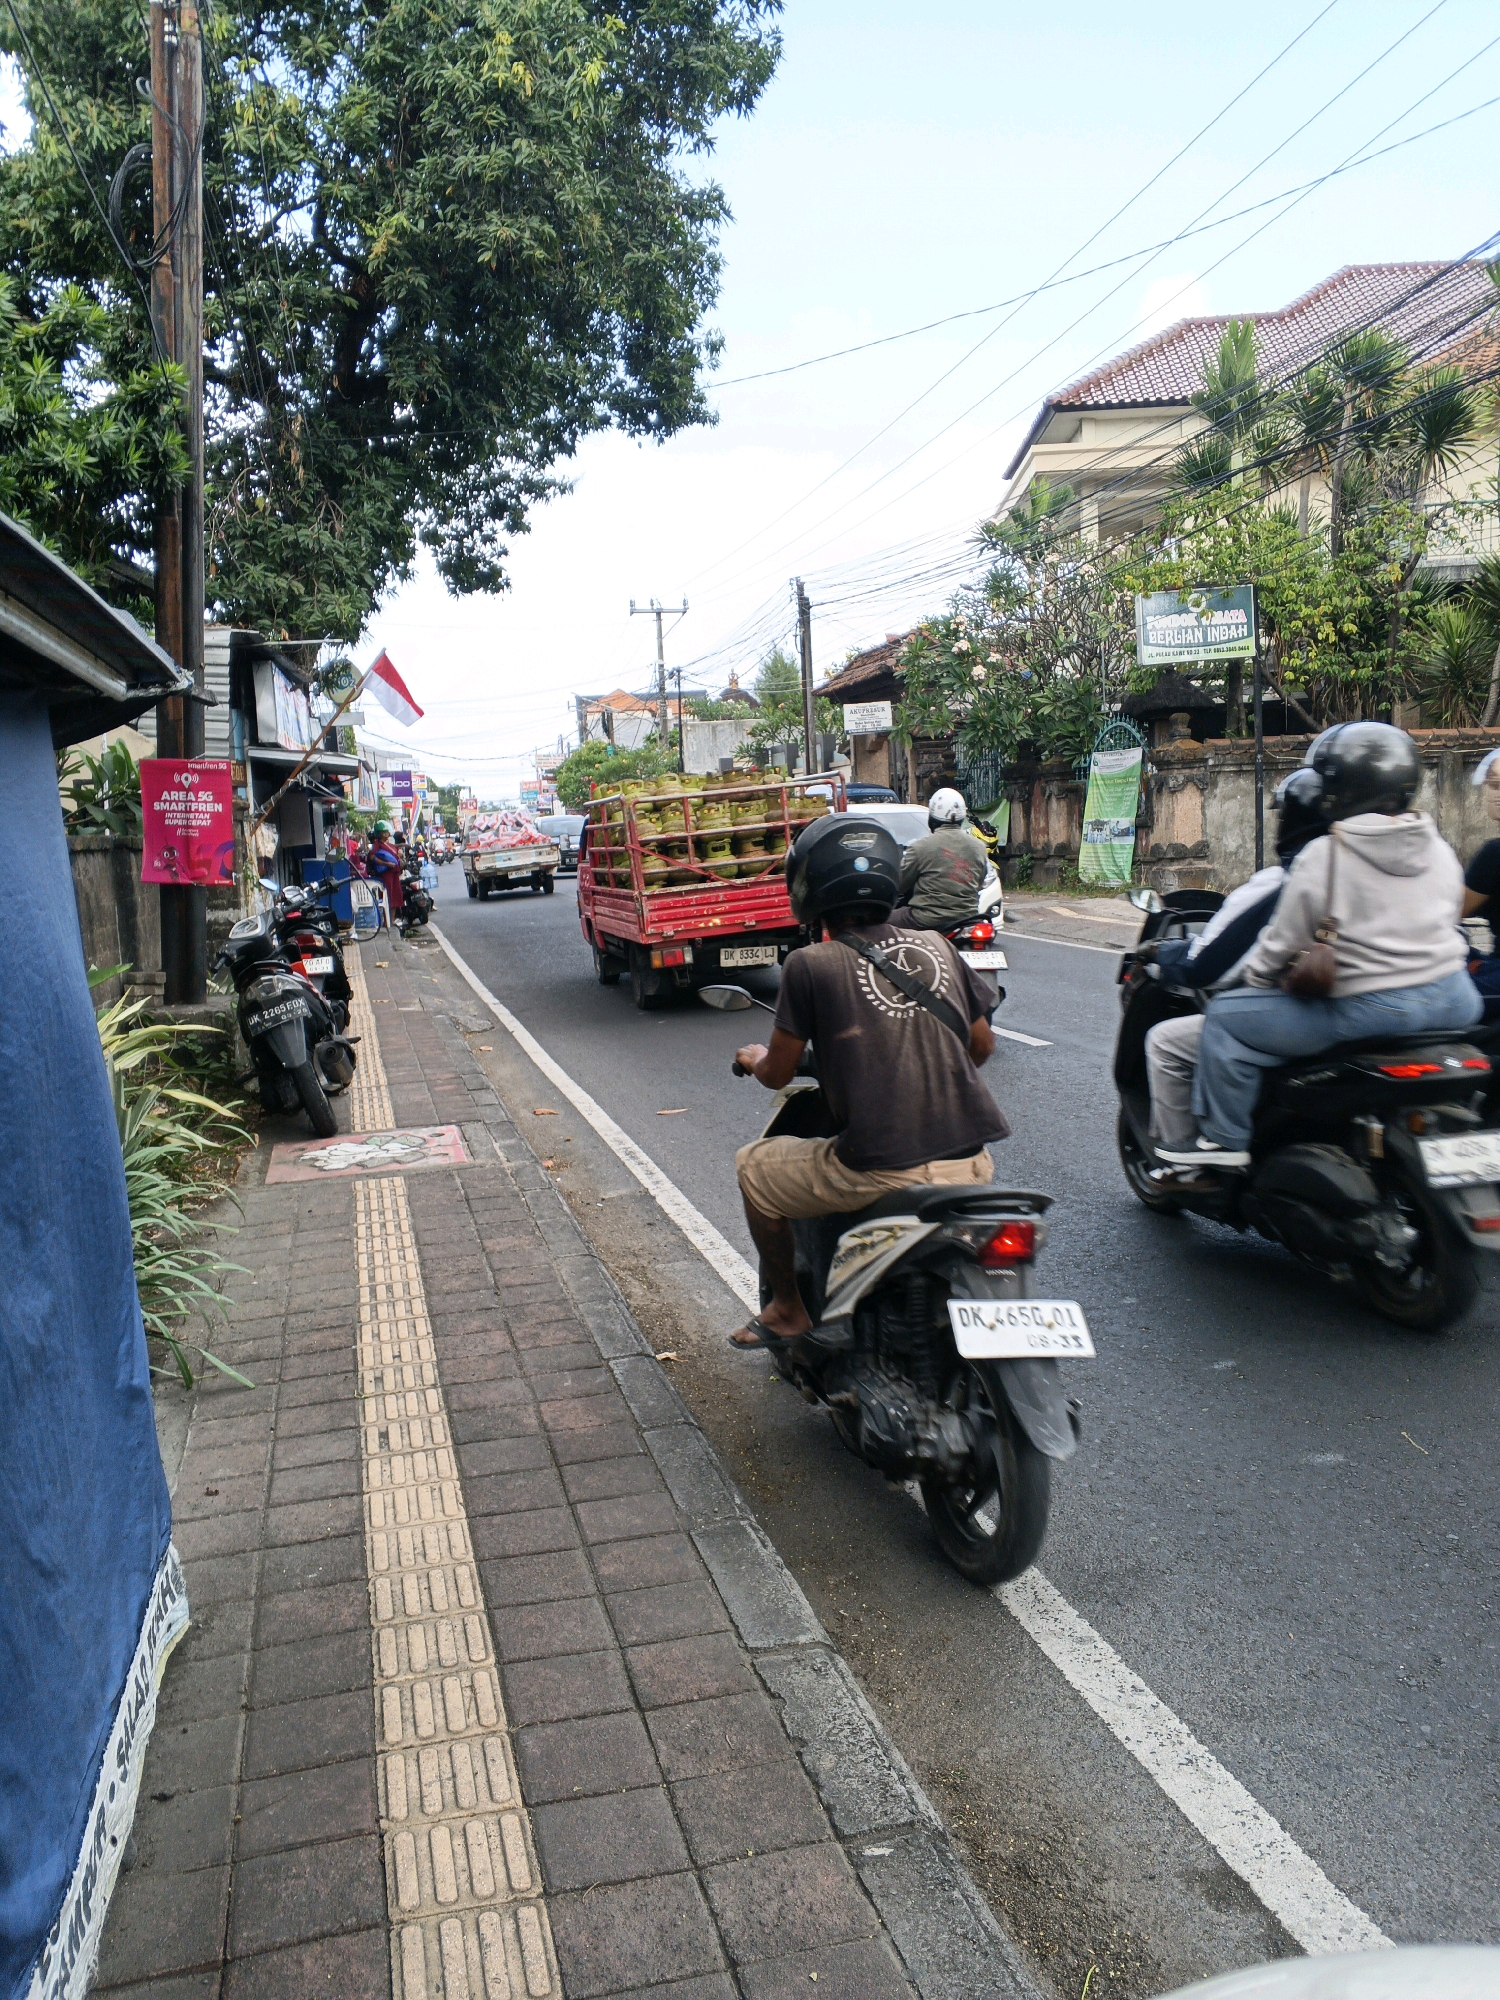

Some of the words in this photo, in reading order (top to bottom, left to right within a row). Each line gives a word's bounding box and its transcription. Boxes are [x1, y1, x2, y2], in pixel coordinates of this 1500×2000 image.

[1146, 613, 1199, 630] PONDOK
[1148, 627, 1204, 645] BERLIAN
[1207, 624, 1248, 642] INDAH
[161, 790, 196, 801] AREA
[197, 790, 214, 802] 5G
[153, 801, 223, 813] SMARTFREN
[724, 949, 735, 960] DK
[739, 948, 760, 960] 8334
[764, 947, 775, 958] LJ
[262, 1003, 287, 1020] 2265
[957, 1306, 990, 1328] DK
[993, 1305, 1046, 1327] 4650
[50, 1801, 108, 2000] AMPUR
[115, 1654, 150, 1785] SALAD
